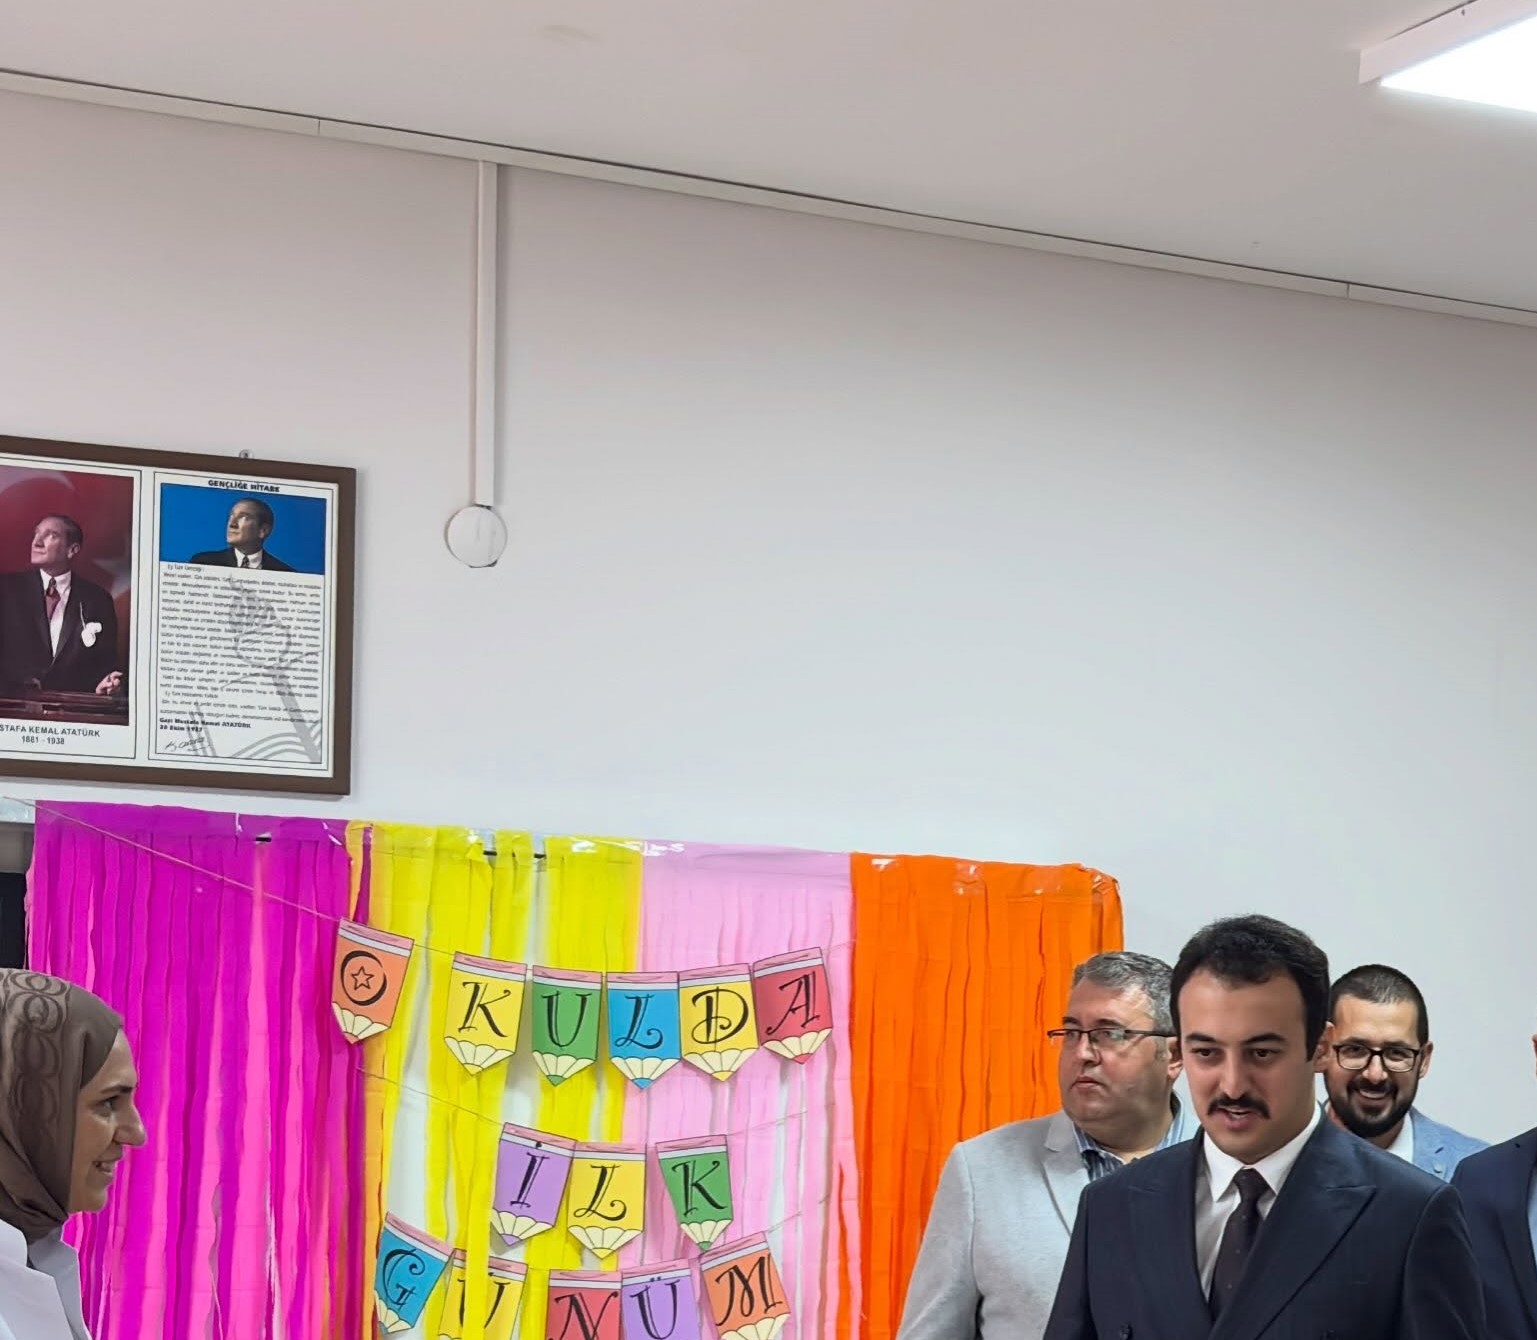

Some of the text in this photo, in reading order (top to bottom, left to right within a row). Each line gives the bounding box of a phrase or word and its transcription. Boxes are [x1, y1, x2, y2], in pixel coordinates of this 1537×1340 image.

[28, 726, 59, 735] KEMAL
[61, 728, 100, 737] ATATÜRK
[47, 736, 65, 745] 1938
[510, 1141, 727, 1221] İLK
